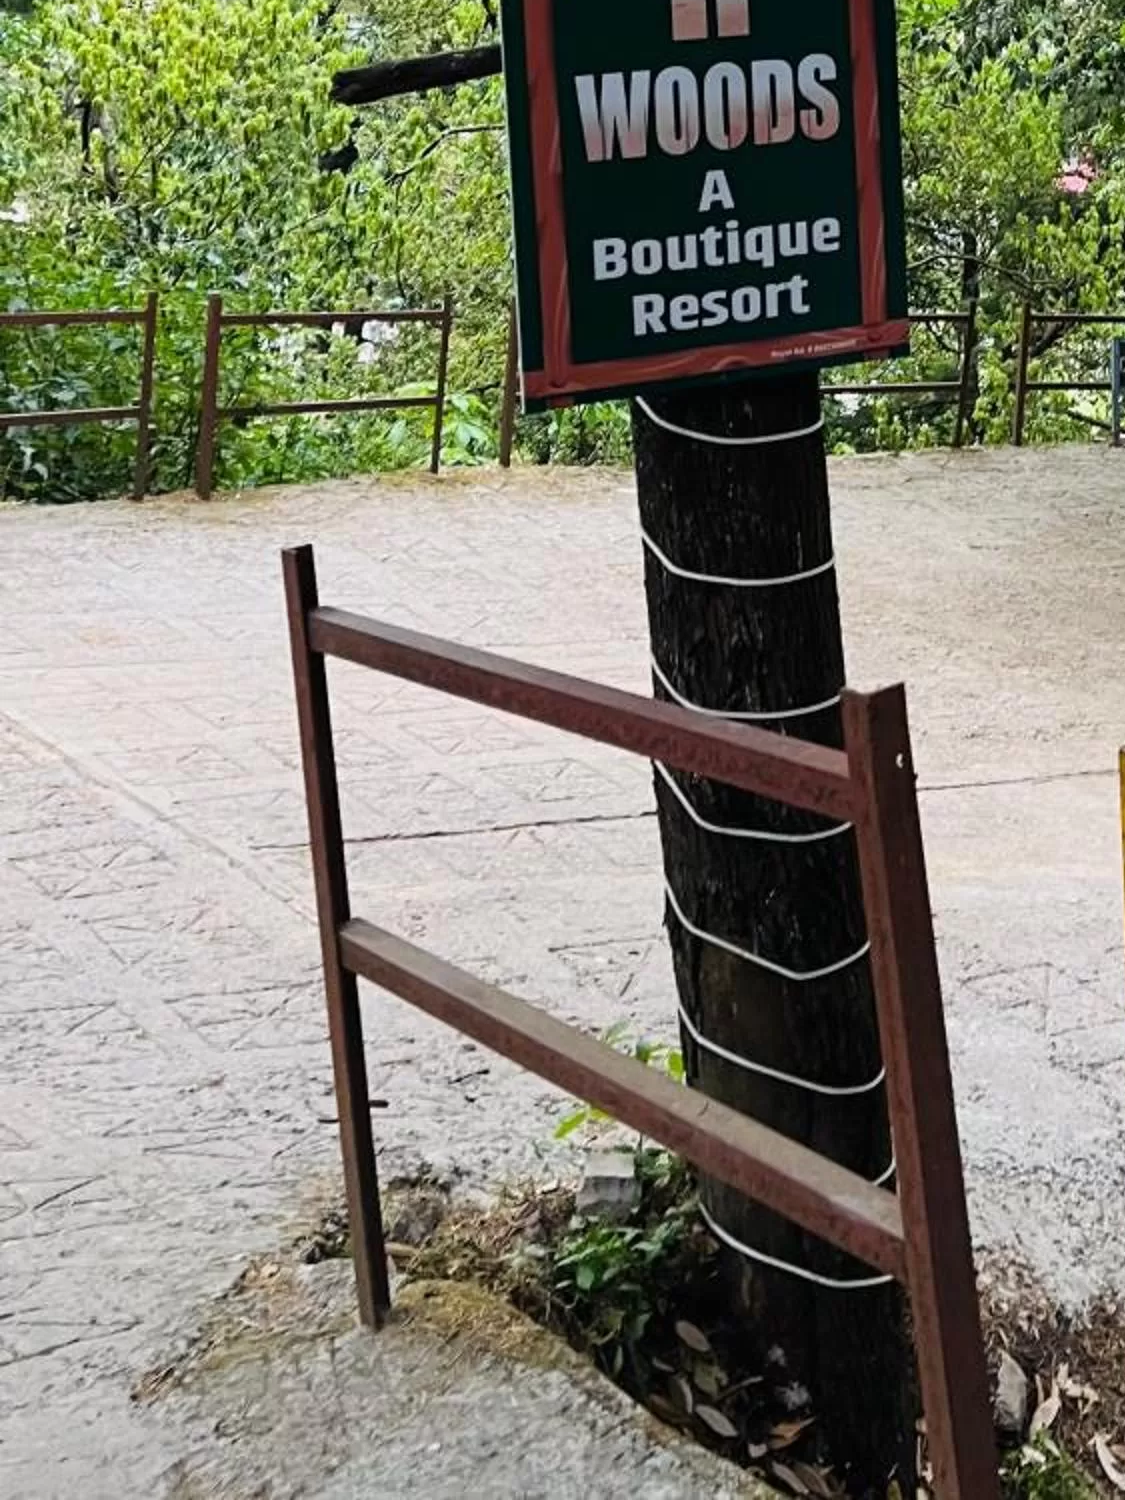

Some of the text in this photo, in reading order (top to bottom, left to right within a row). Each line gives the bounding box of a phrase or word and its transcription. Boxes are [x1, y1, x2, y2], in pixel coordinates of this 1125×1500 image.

[575, 53, 840, 162] WOODS
[698, 169, 735, 212] A
[593, 216, 841, 281] Boutique
[632, 274, 811, 336] Resort
